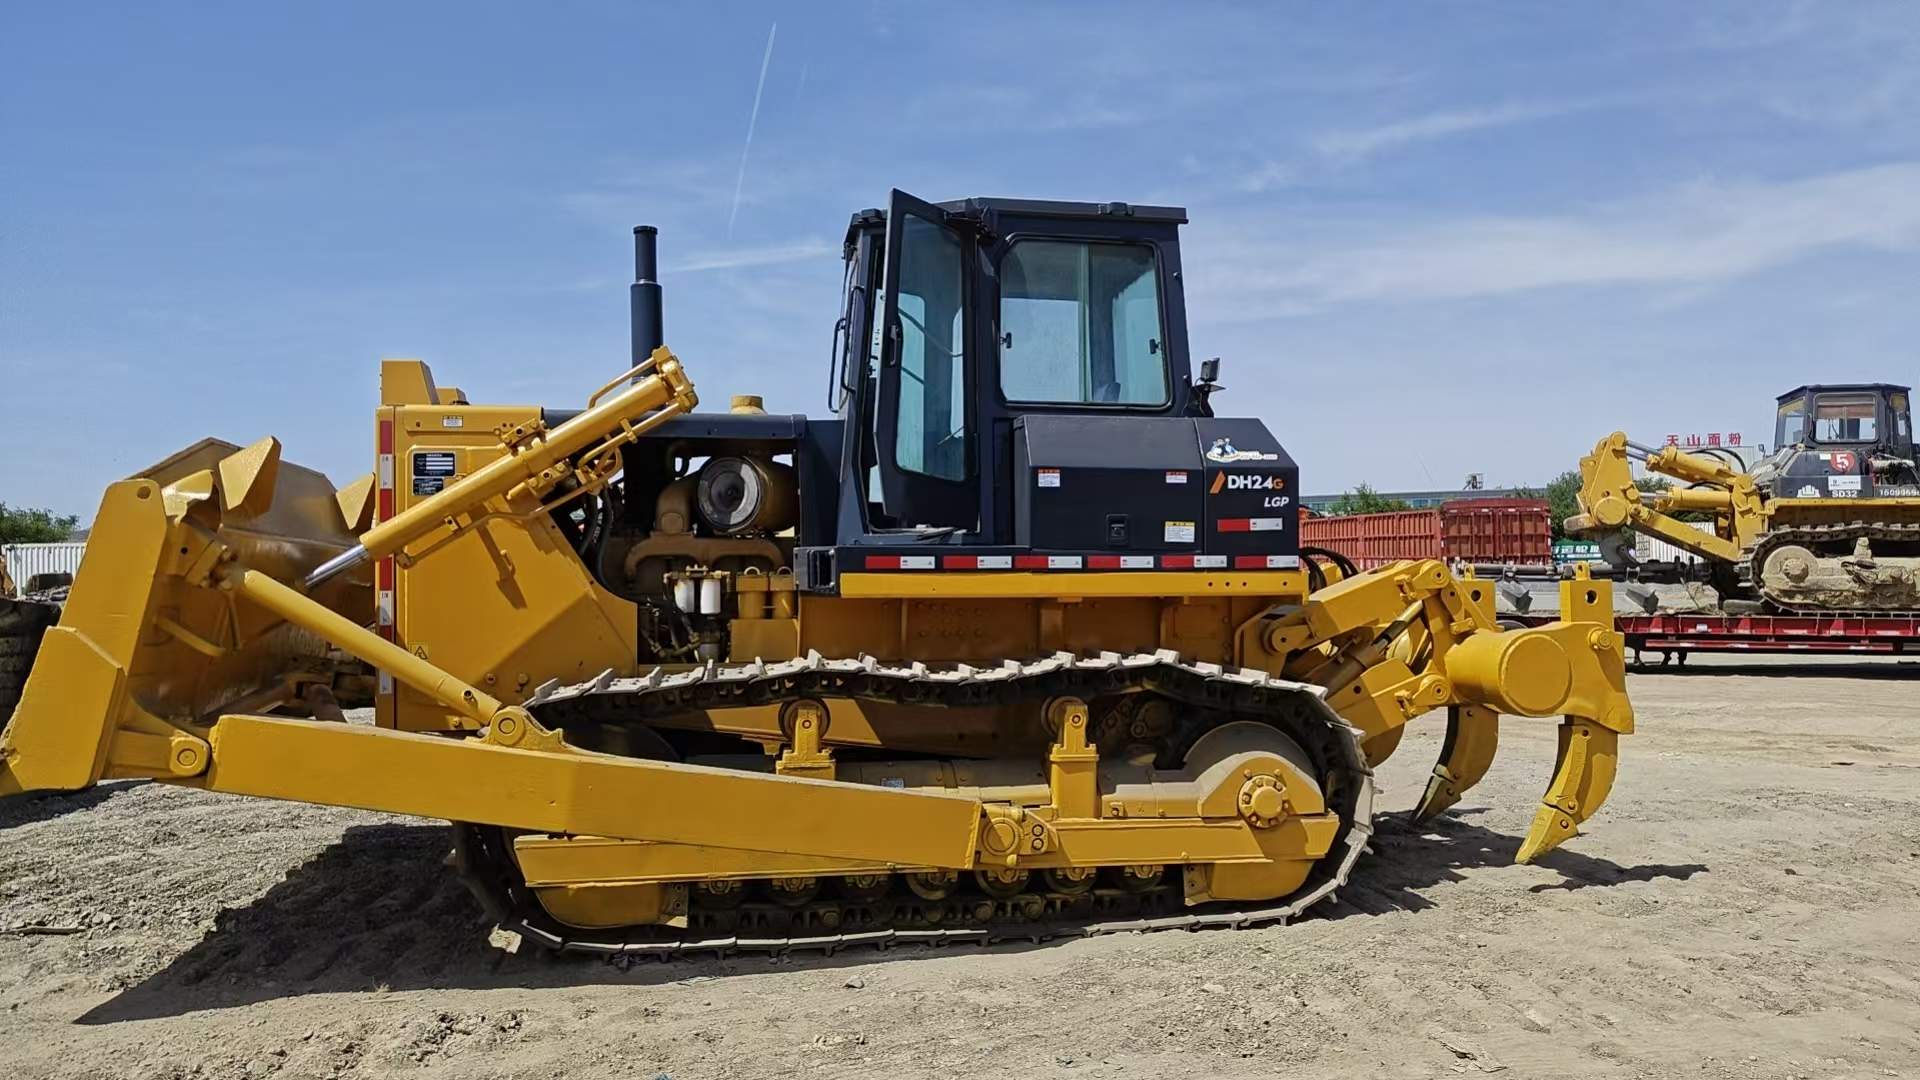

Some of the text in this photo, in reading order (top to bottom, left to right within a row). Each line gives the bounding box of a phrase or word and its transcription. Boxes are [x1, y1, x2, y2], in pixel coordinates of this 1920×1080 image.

[1666, 432, 1742, 447] 天山面粉
[1836, 453, 1849, 469] 5
[1227, 474, 1284, 490] DH24G
[1831, 489, 1858, 498] SD32
[1263, 496, 1290, 508] LGP
